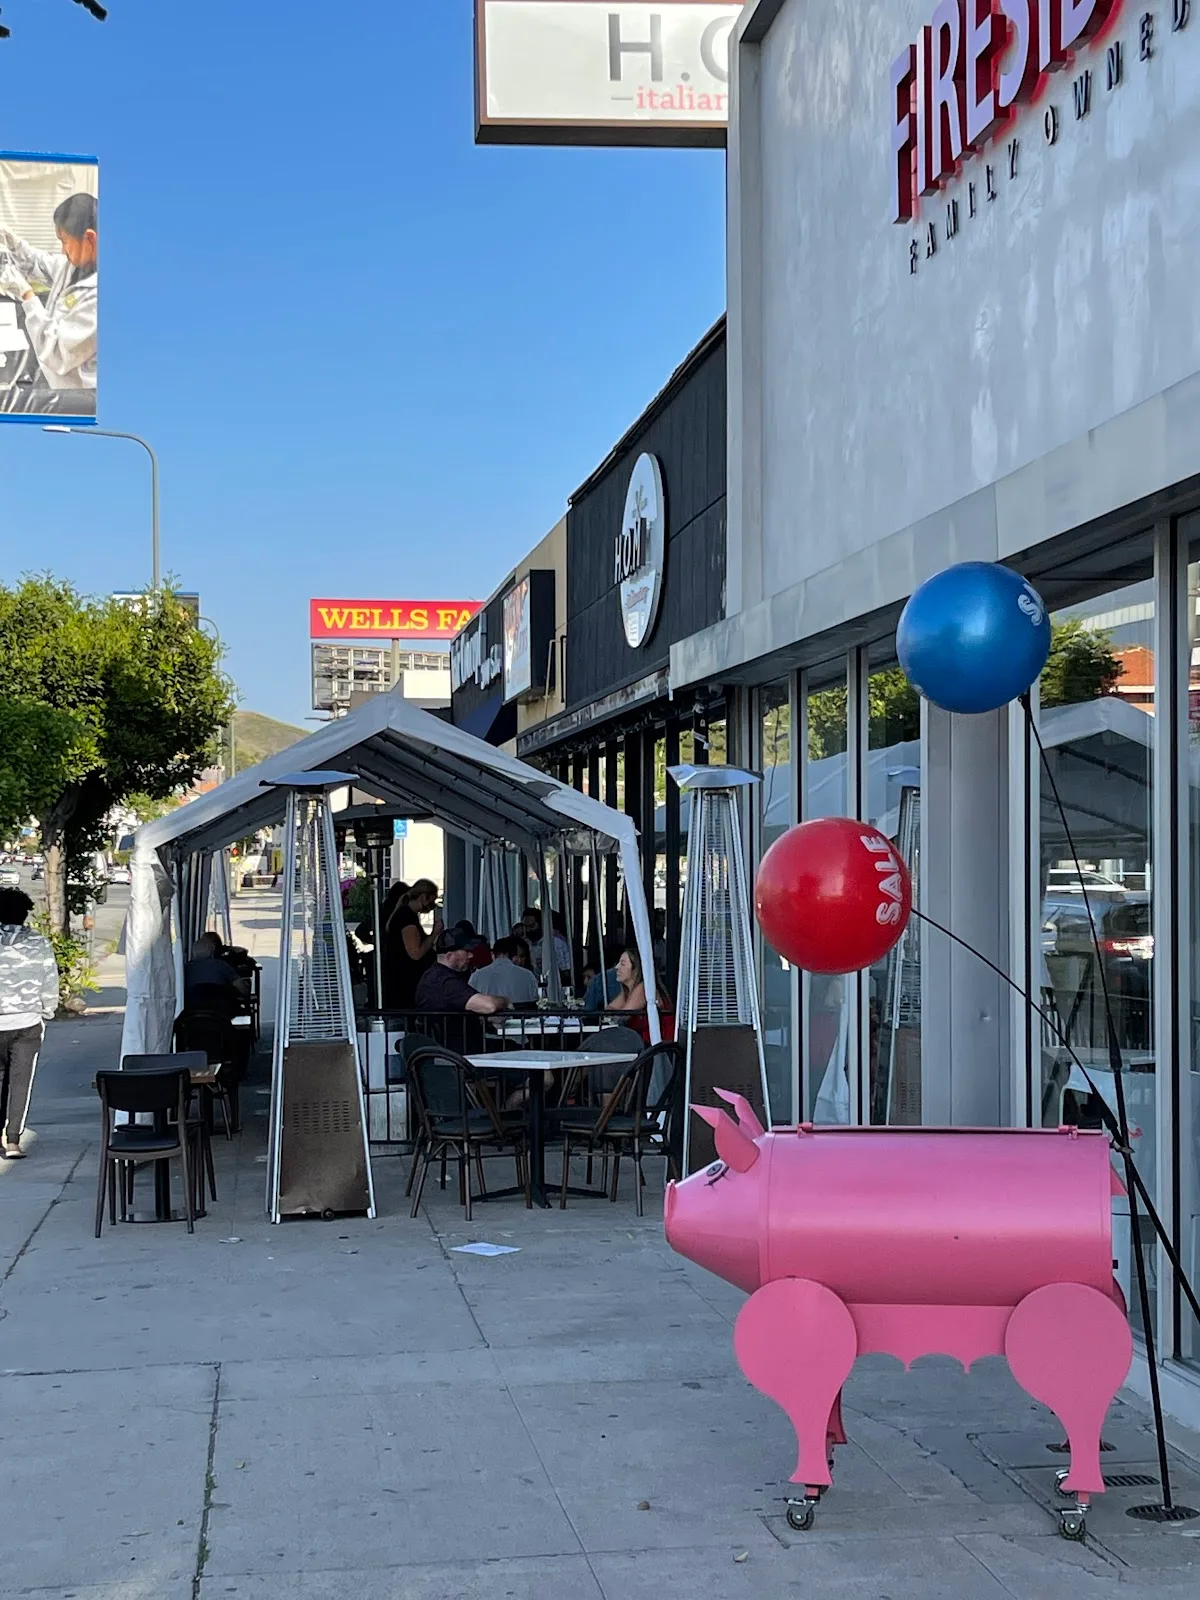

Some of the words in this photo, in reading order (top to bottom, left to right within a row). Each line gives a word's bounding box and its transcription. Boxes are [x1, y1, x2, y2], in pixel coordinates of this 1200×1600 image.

[889, 0, 1112, 224] FIRES
[909, 138, 1019, 275] FAMILY
[317, 608, 429, 631] WELLS
[860, 835, 903, 925] SALE
